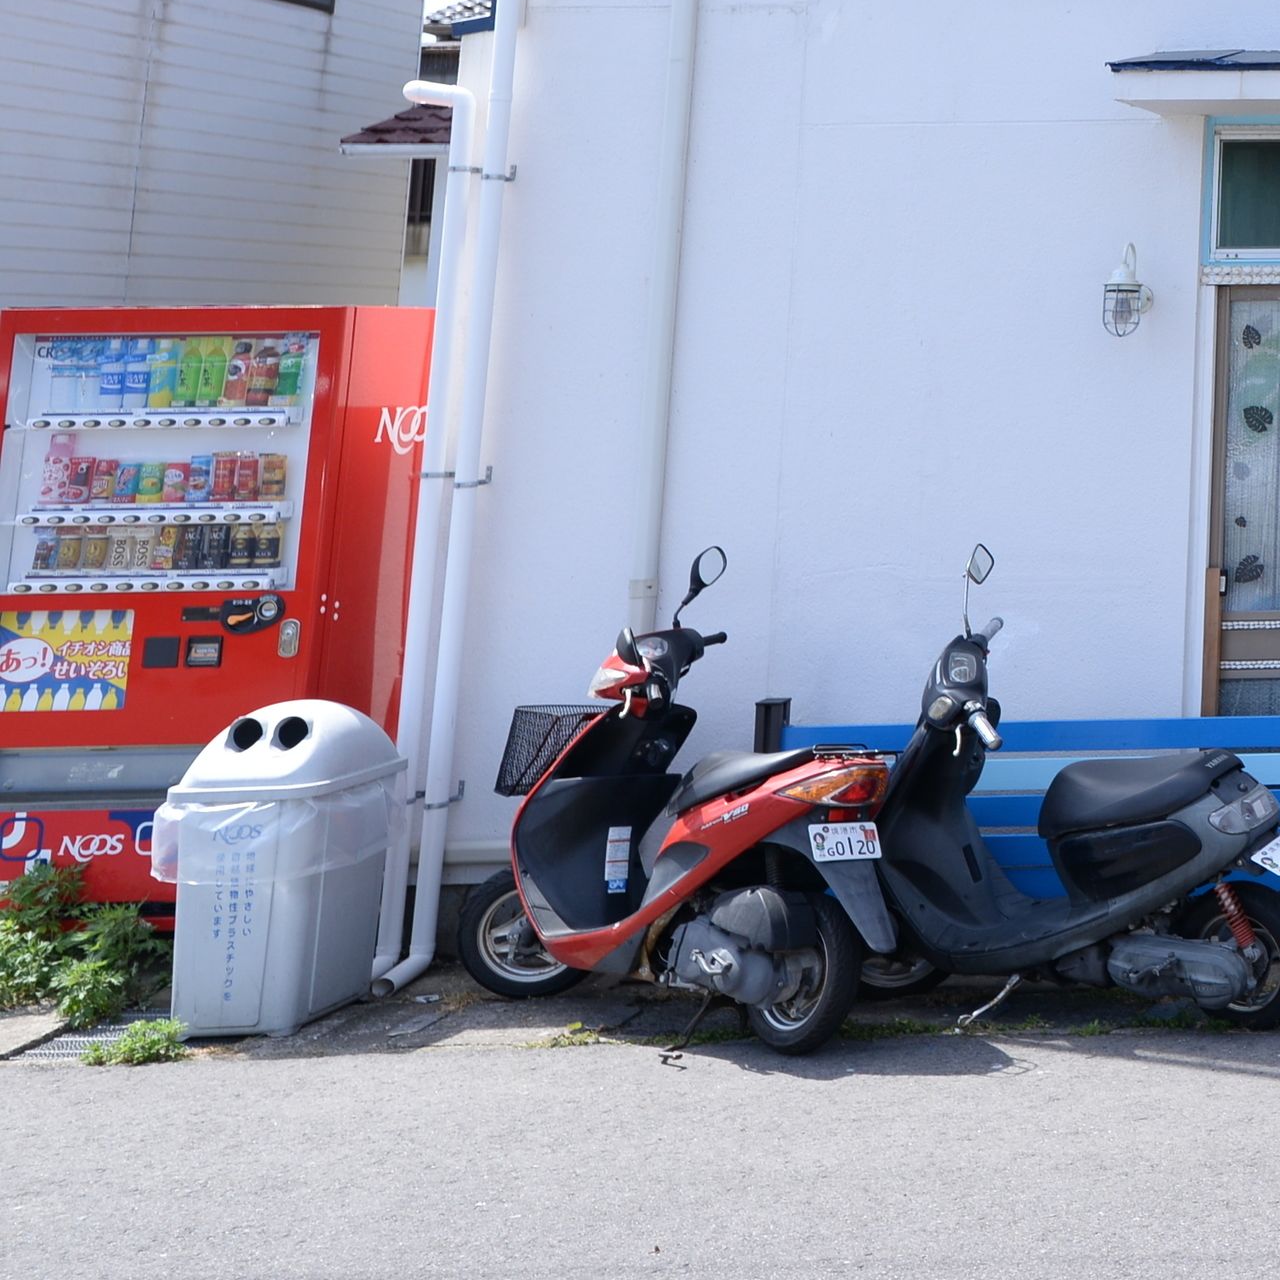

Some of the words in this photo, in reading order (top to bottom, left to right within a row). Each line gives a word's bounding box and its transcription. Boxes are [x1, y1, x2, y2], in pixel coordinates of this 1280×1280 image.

[374, 406, 427, 455] NOO
[112, 540, 127, 567] BOSS
[135, 540, 149, 567] BOSS
[57, 833, 125, 862] NOOS
[213, 824, 263, 845] NOOS
